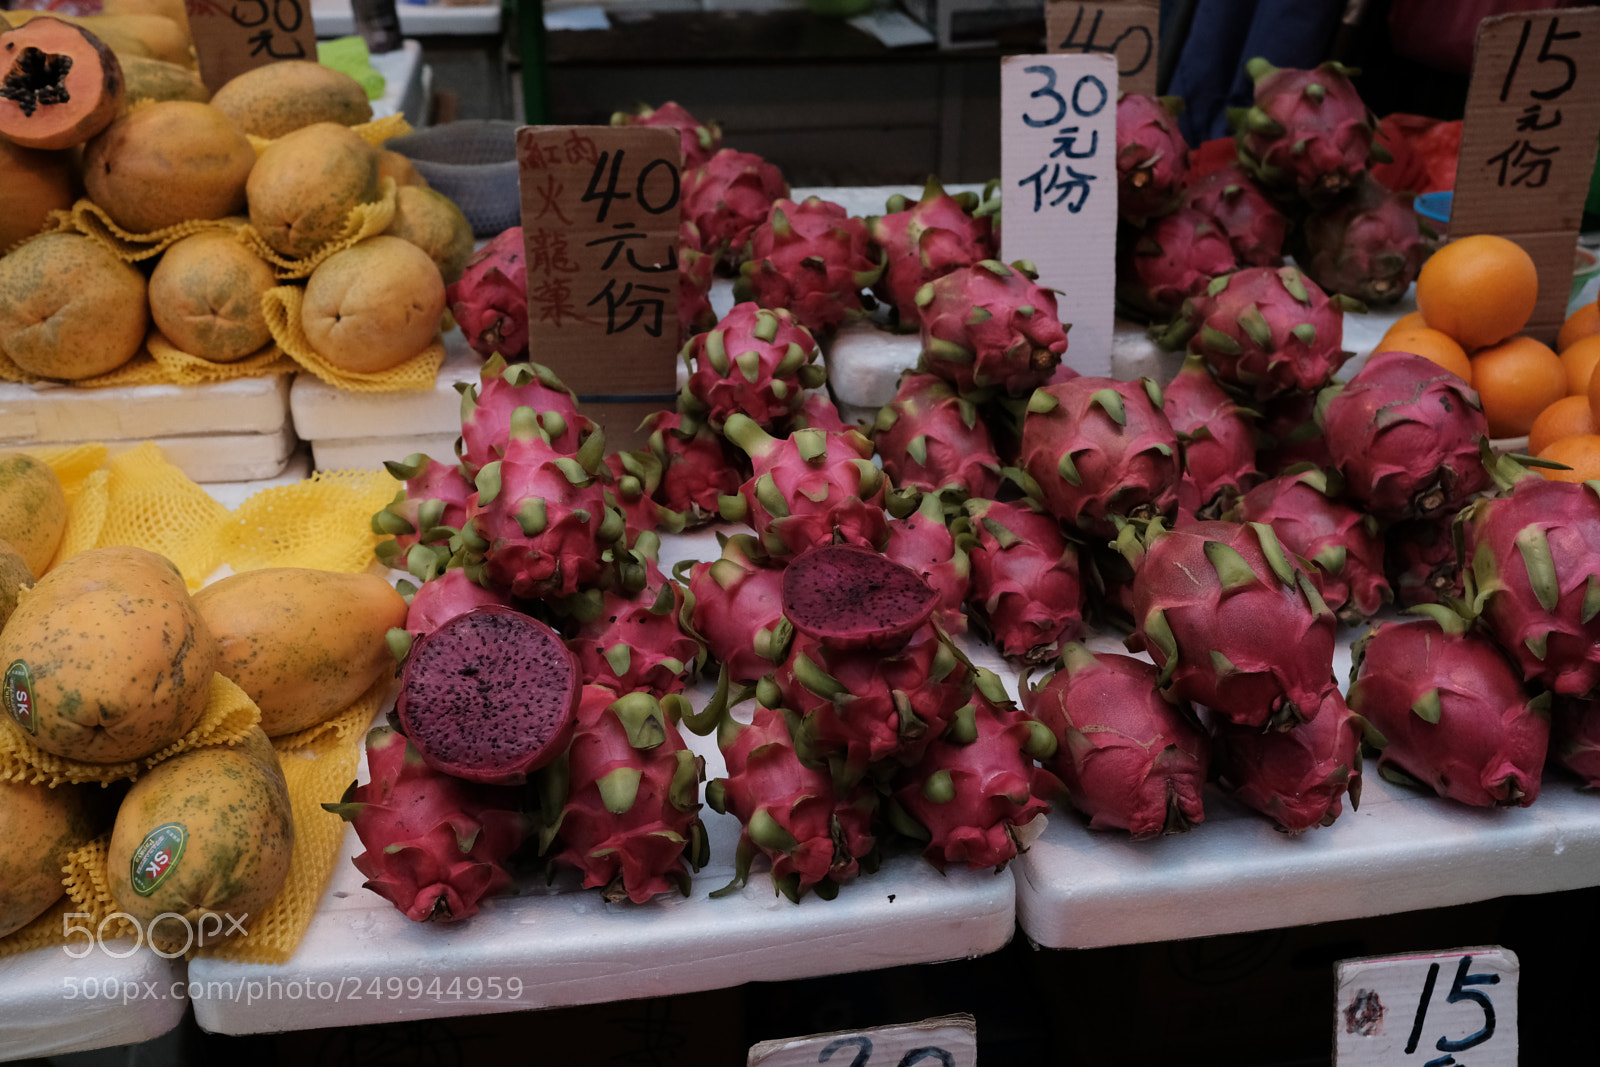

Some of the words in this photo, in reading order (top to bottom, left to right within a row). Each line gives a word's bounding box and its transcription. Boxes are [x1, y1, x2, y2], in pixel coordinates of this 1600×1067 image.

[1059, 6, 1153, 77] 40
[1500, 17, 1581, 102] 15
[1022, 65, 1108, 128] 30
[581, 149, 680, 223] 40
[16, 690, 29, 715] SK
[145, 850, 169, 878] SK
[1404, 955, 1501, 1054] 15
